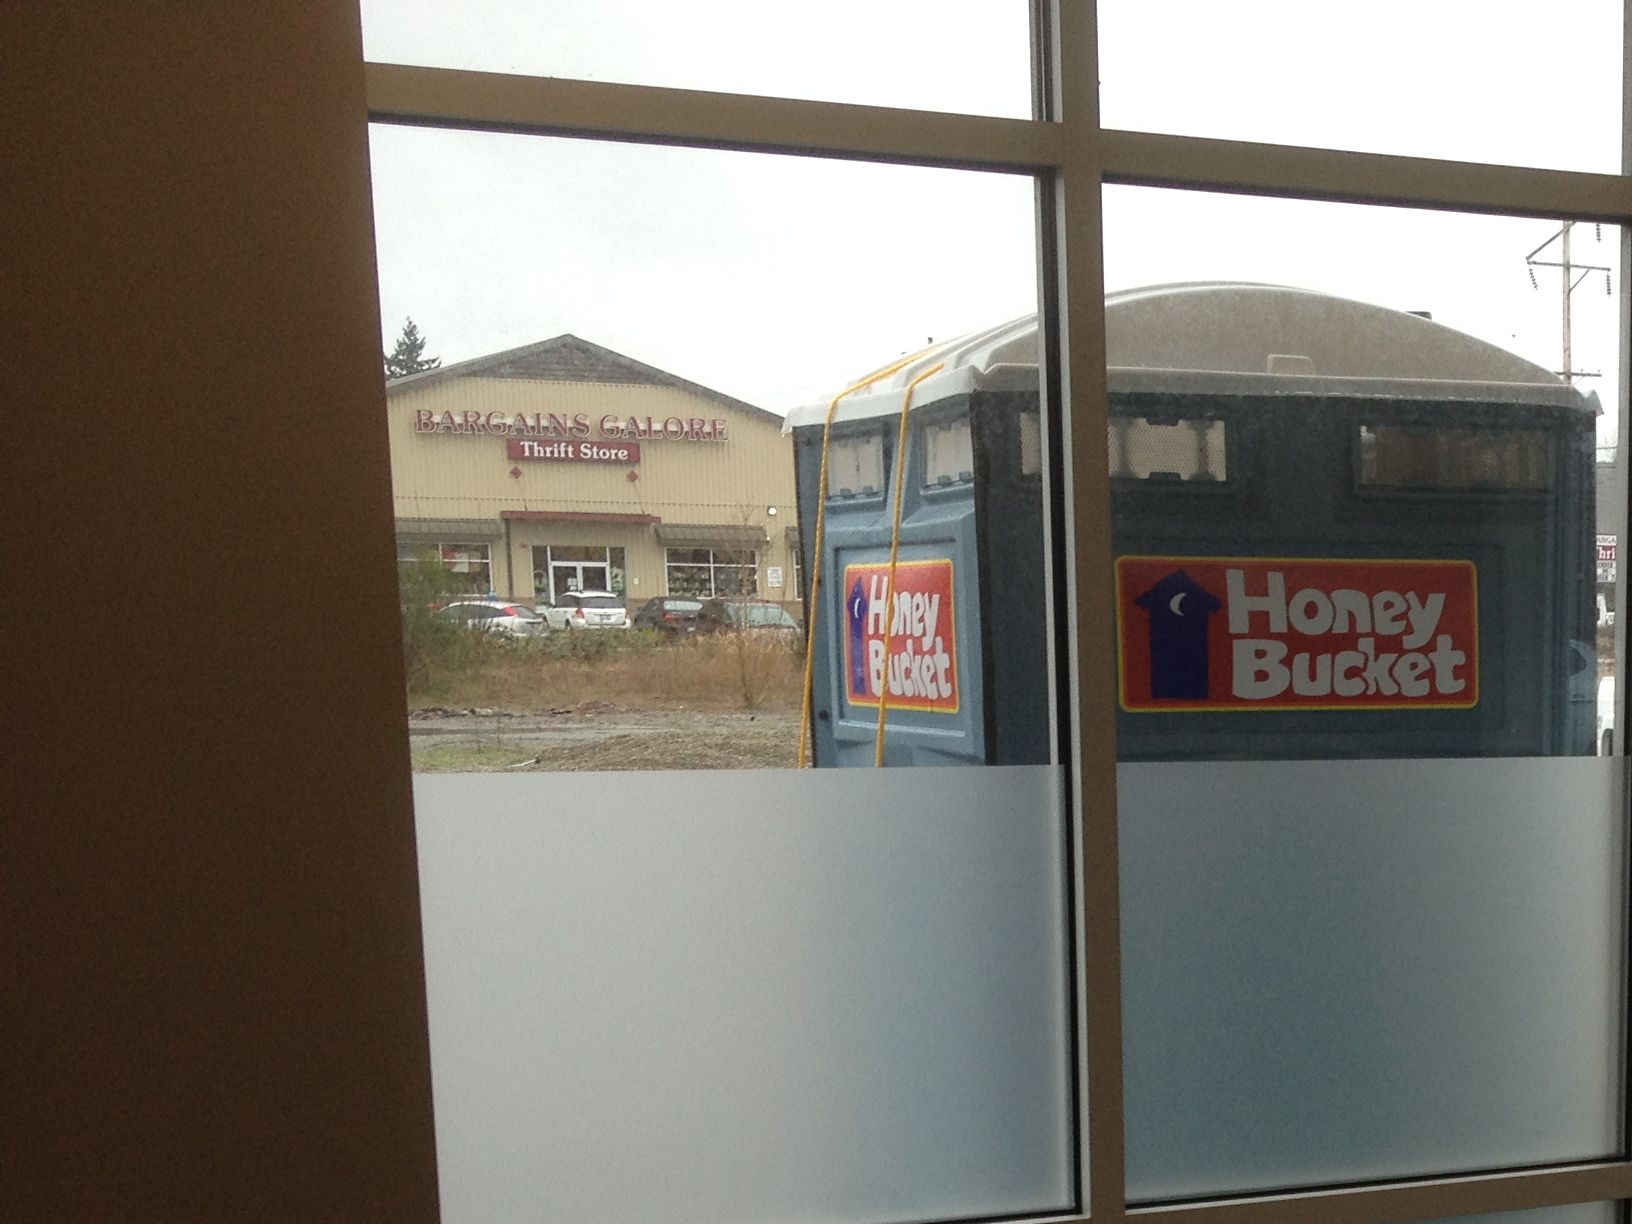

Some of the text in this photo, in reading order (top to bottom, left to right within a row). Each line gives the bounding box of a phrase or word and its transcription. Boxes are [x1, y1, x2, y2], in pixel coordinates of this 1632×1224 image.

[415, 409, 729, 441] BARGAINS GALORE
[520, 441, 629, 461] Thrift Store
[868, 575, 940, 651] Honey
[1226, 569, 1446, 649] Honey
[869, 636, 952, 700] Bucket
[1232, 634, 1466, 699] Bucket
